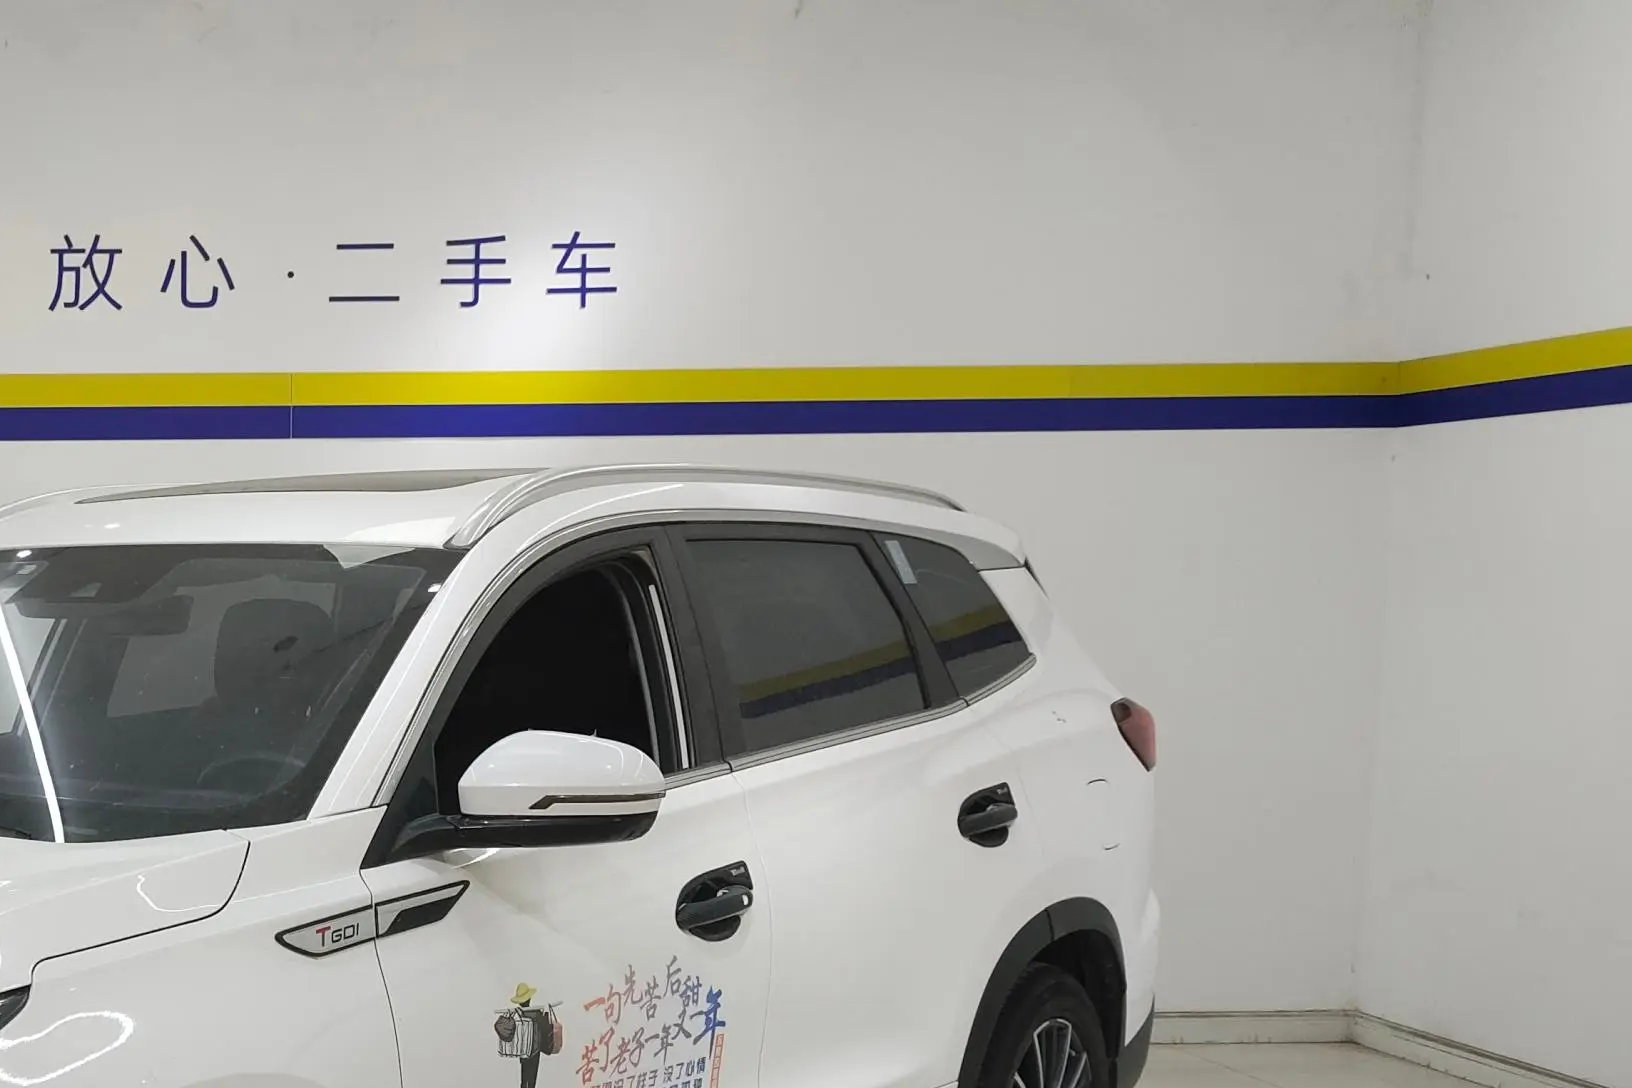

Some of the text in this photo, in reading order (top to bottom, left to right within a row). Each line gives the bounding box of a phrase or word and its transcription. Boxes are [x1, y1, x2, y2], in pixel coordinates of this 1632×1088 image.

[316, 923, 360, 947] TGDI
[584, 955, 702, 1025] 一句先苦后甜
[575, 986, 726, 1084] 苦了老子一年又一年
